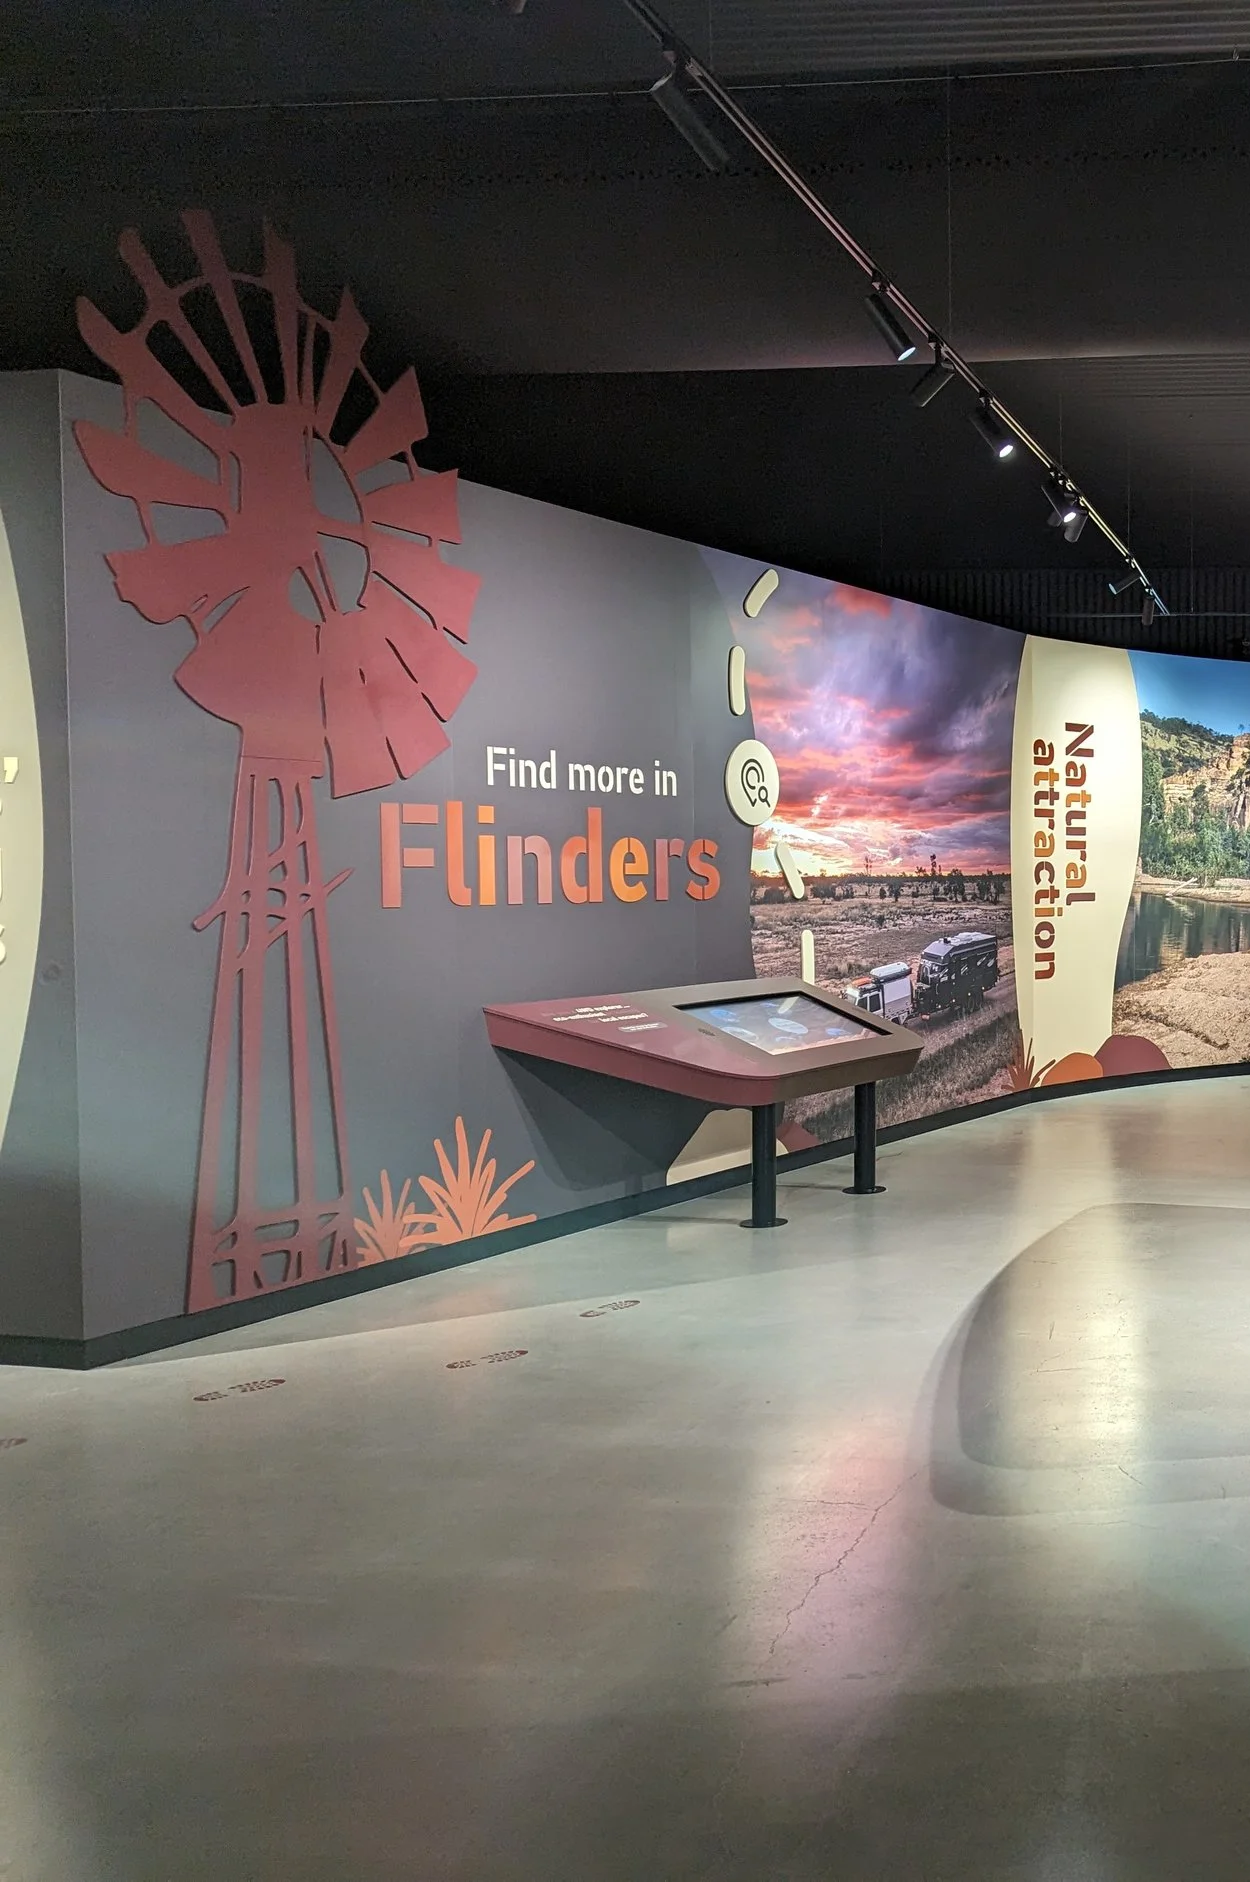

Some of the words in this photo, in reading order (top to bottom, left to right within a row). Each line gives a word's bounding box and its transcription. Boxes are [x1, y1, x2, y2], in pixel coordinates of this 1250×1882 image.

[486, 746, 557, 790] Find
[568, 762, 645, 795] more
[653, 760, 678, 797] in
[1064, 721, 1096, 906] Natural
[380, 800, 721, 909] Flinders
[1032, 738, 1064, 980] attraction
